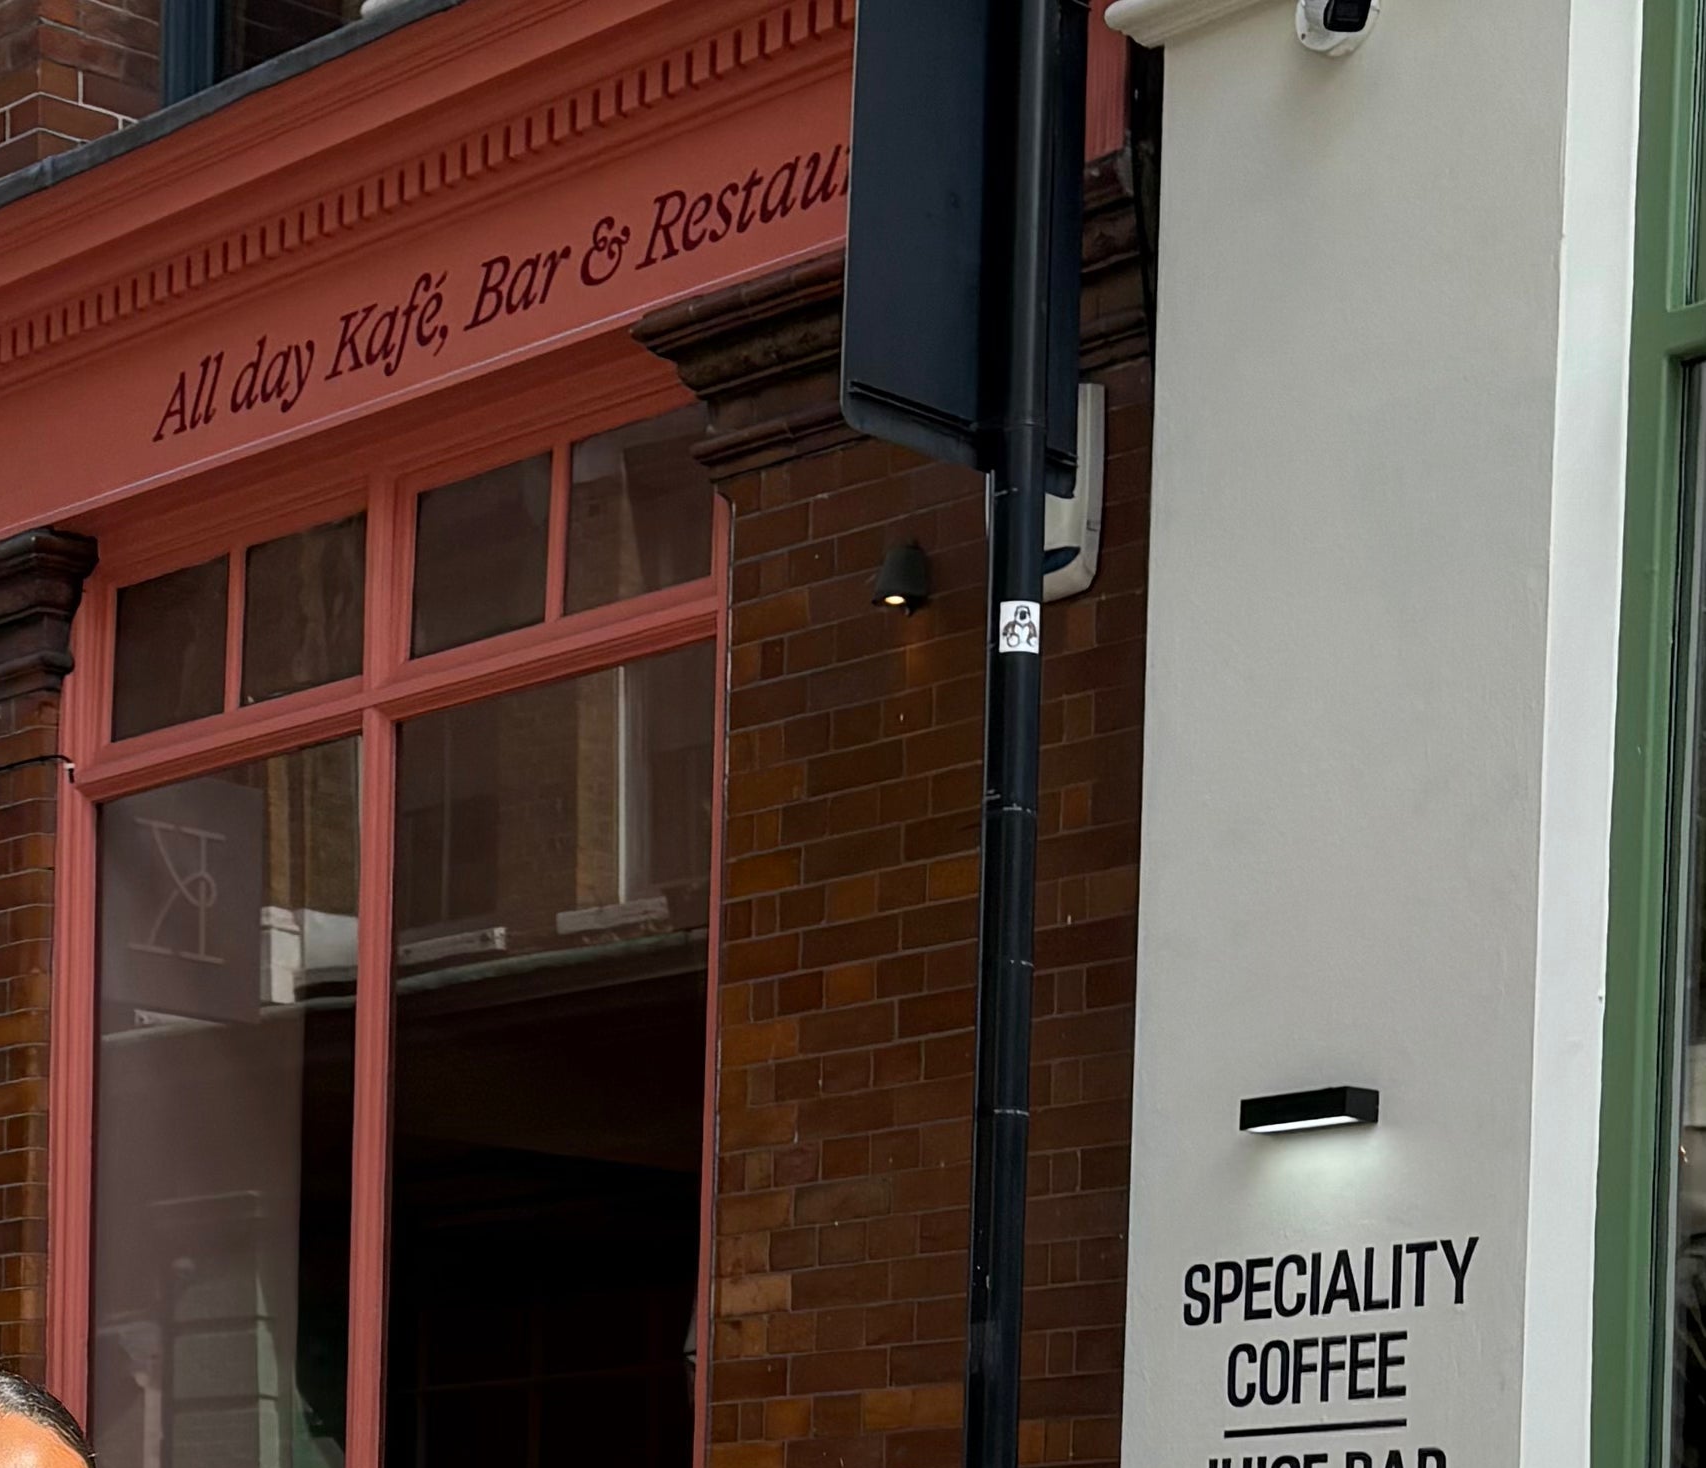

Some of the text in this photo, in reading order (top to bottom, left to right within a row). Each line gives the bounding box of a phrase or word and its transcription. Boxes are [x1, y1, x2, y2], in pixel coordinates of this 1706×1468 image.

[152, 351, 225, 443] All
[229, 334, 315, 414] day
[324, 270, 448, 377] Kafé,
[462, 244, 572, 332] Bar
[579, 215, 631, 286] &
[1183, 1236, 1480, 1327] SPECIALITY
[1226, 1331, 1408, 1408] COFFEE
